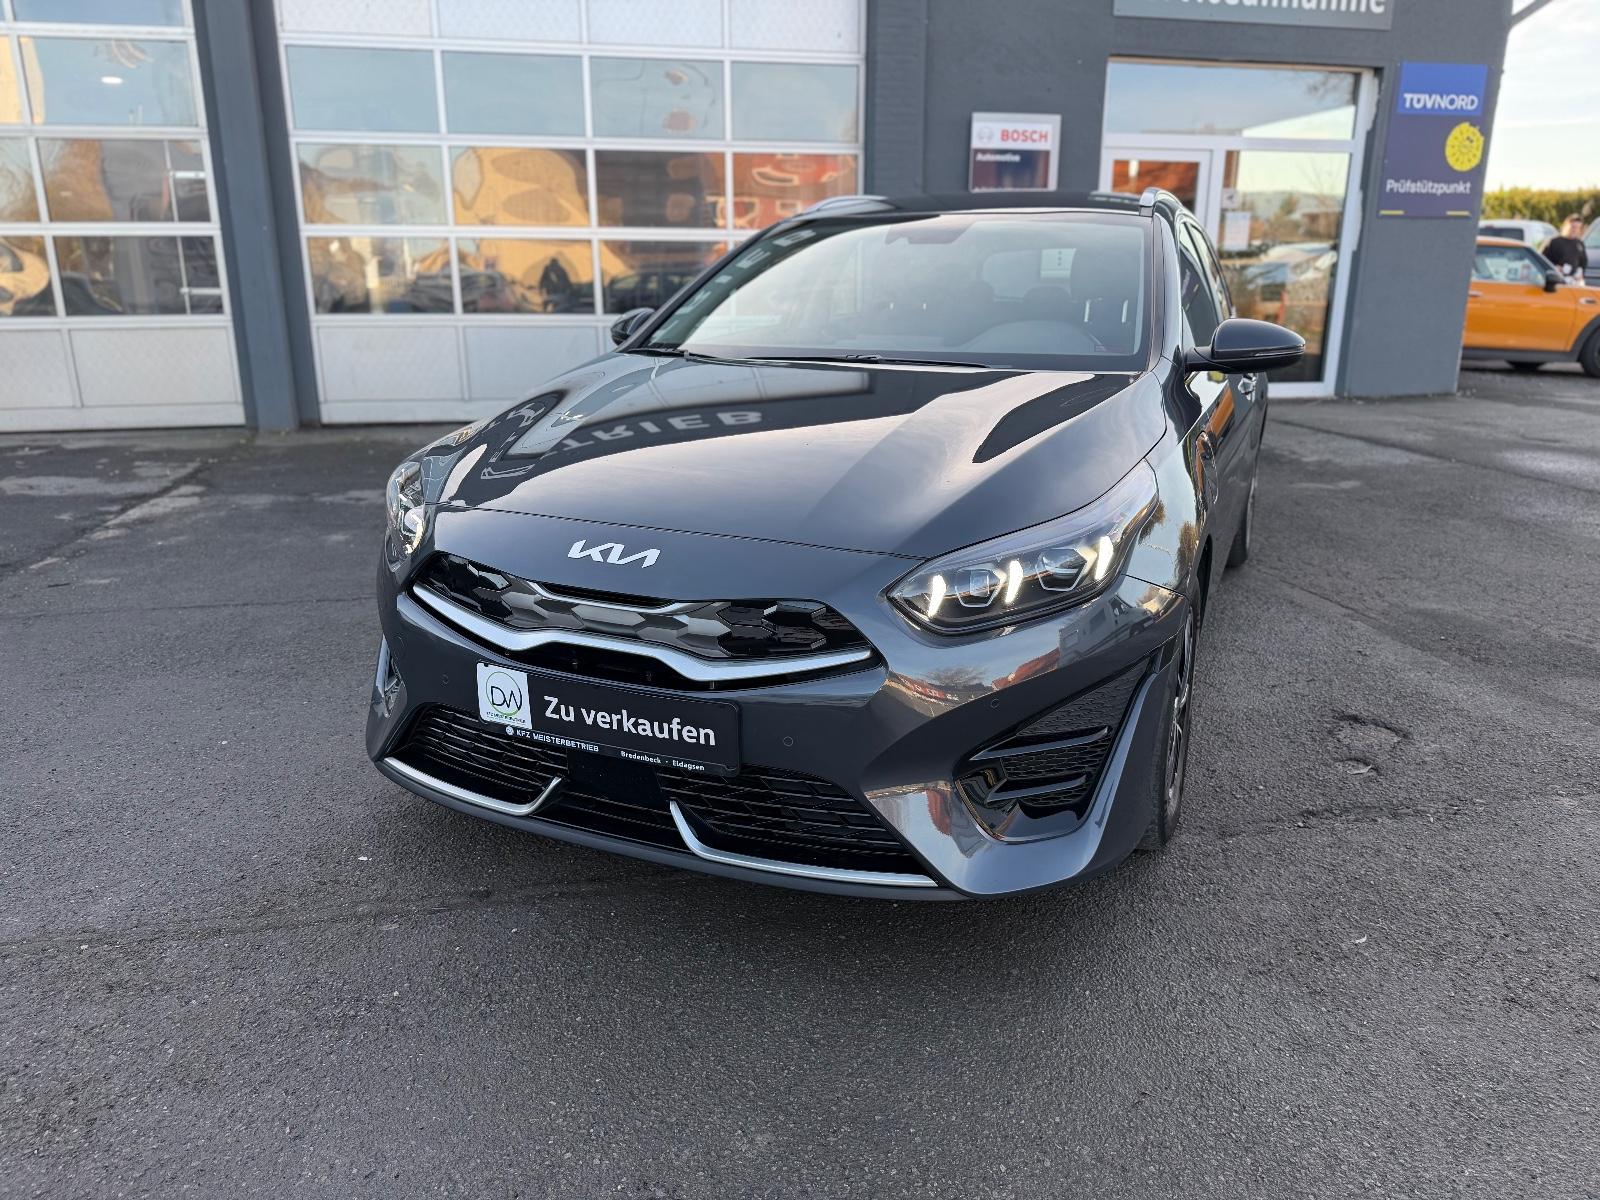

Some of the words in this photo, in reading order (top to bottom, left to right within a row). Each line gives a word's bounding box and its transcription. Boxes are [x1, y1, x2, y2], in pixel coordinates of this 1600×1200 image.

[1001, 128, 1048, 142] BOSCH
[1386, 178, 1471, 196] Prüfstützpunkt
[567, 539, 661, 568] KIA
[544, 695, 575, 722] Zu
[581, 707, 716, 746] verkaufen
[516, 729, 531, 738] KFZ
[532, 732, 599, 752] MEISTERBETRIEB
[620, 750, 661, 764] Bredenbeck
[672, 759, 705, 771] Eldagsen
